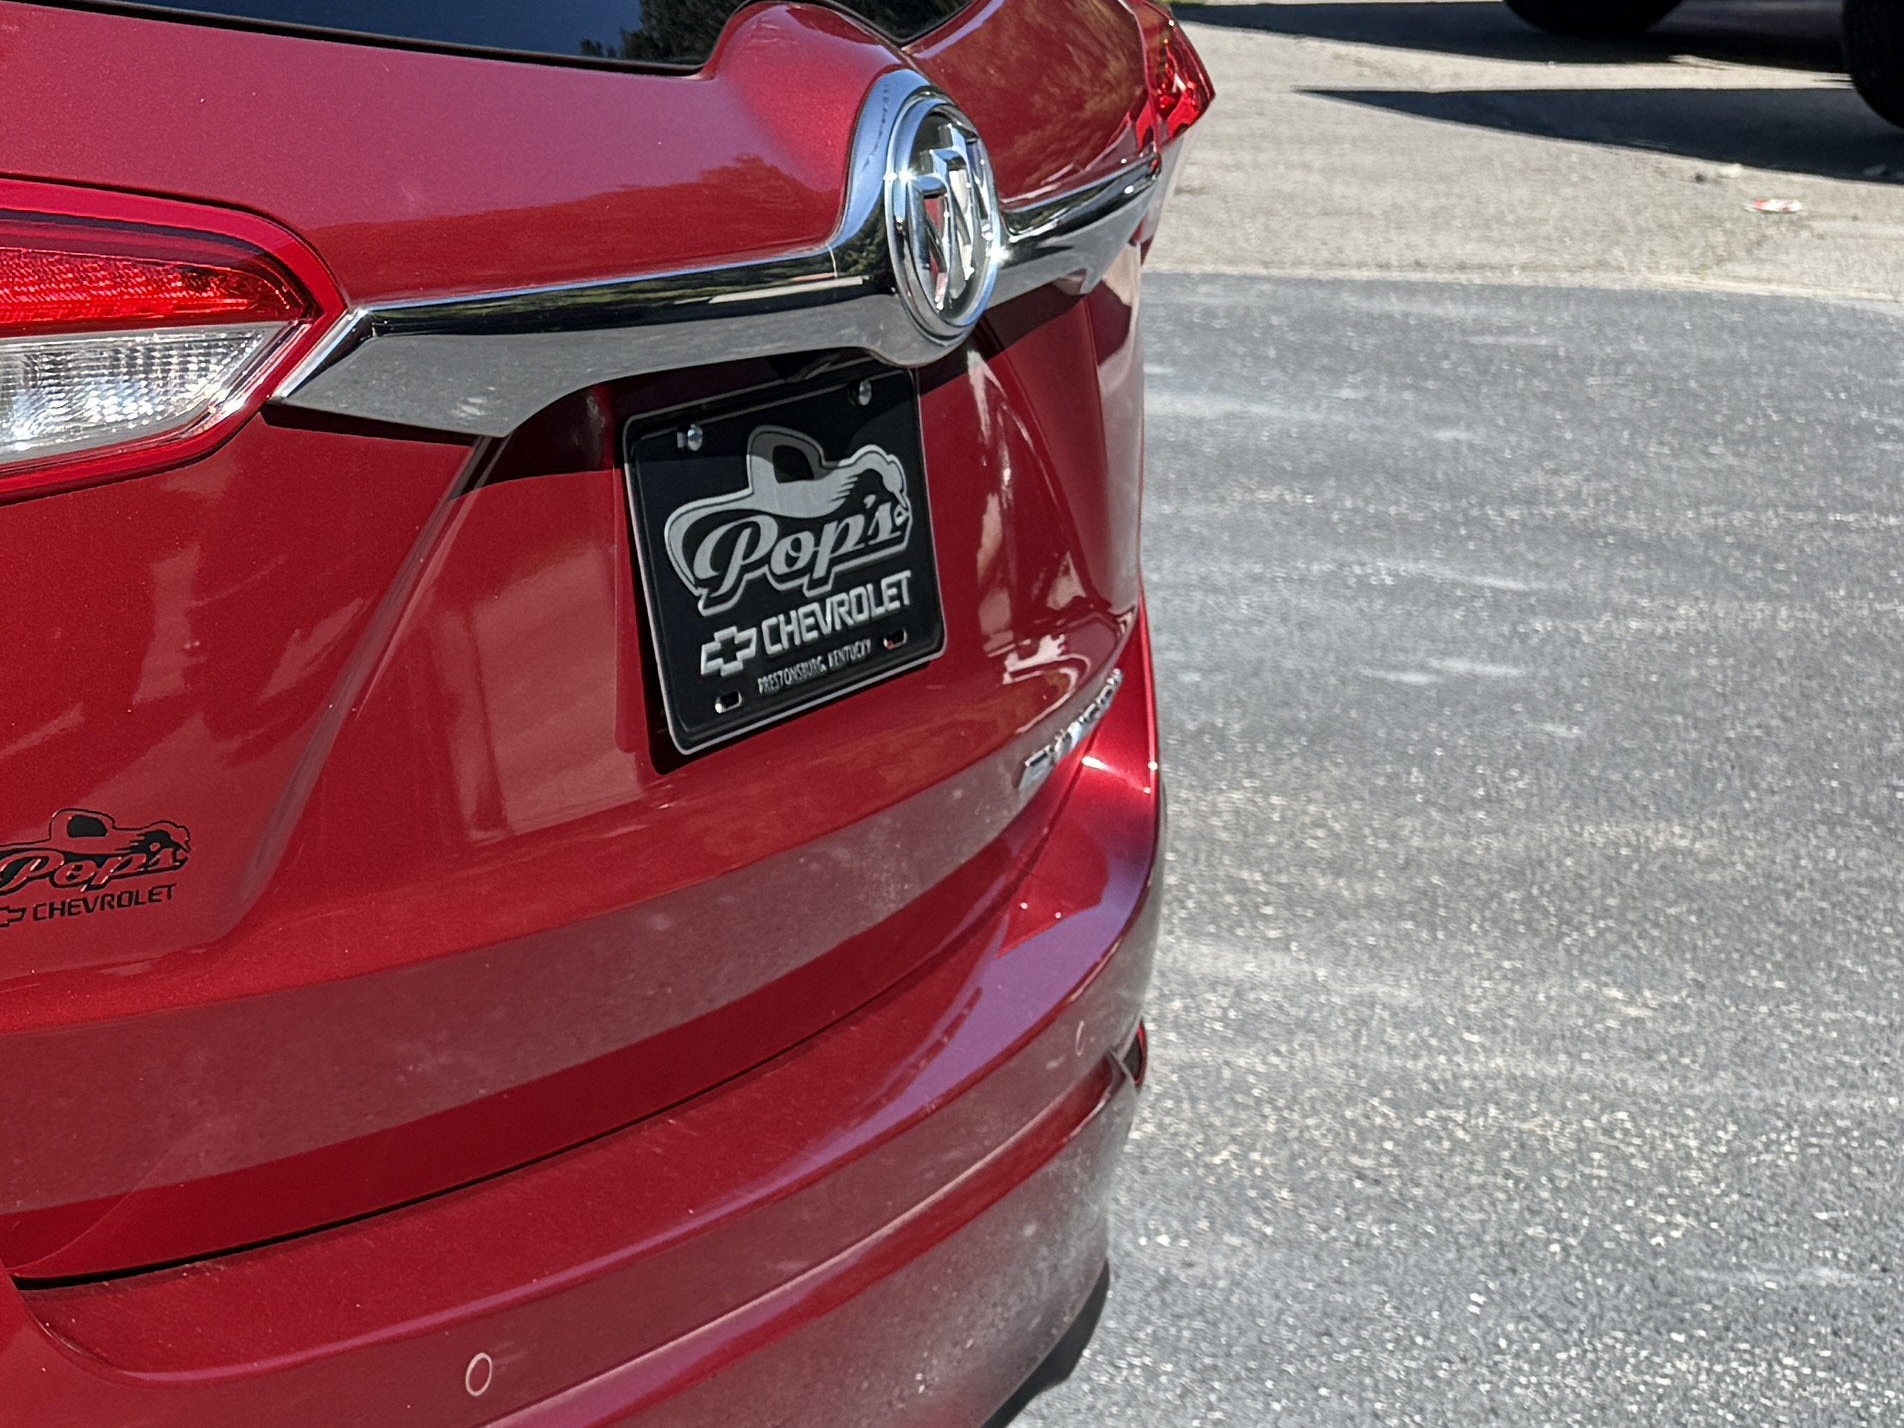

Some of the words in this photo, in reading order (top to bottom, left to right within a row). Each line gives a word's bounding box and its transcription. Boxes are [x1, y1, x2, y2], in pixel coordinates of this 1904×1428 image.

[692, 494, 902, 597] Pop's
[761, 570, 912, 656] CHEVROLET
[32, 883, 176, 921] CHEVROLET
